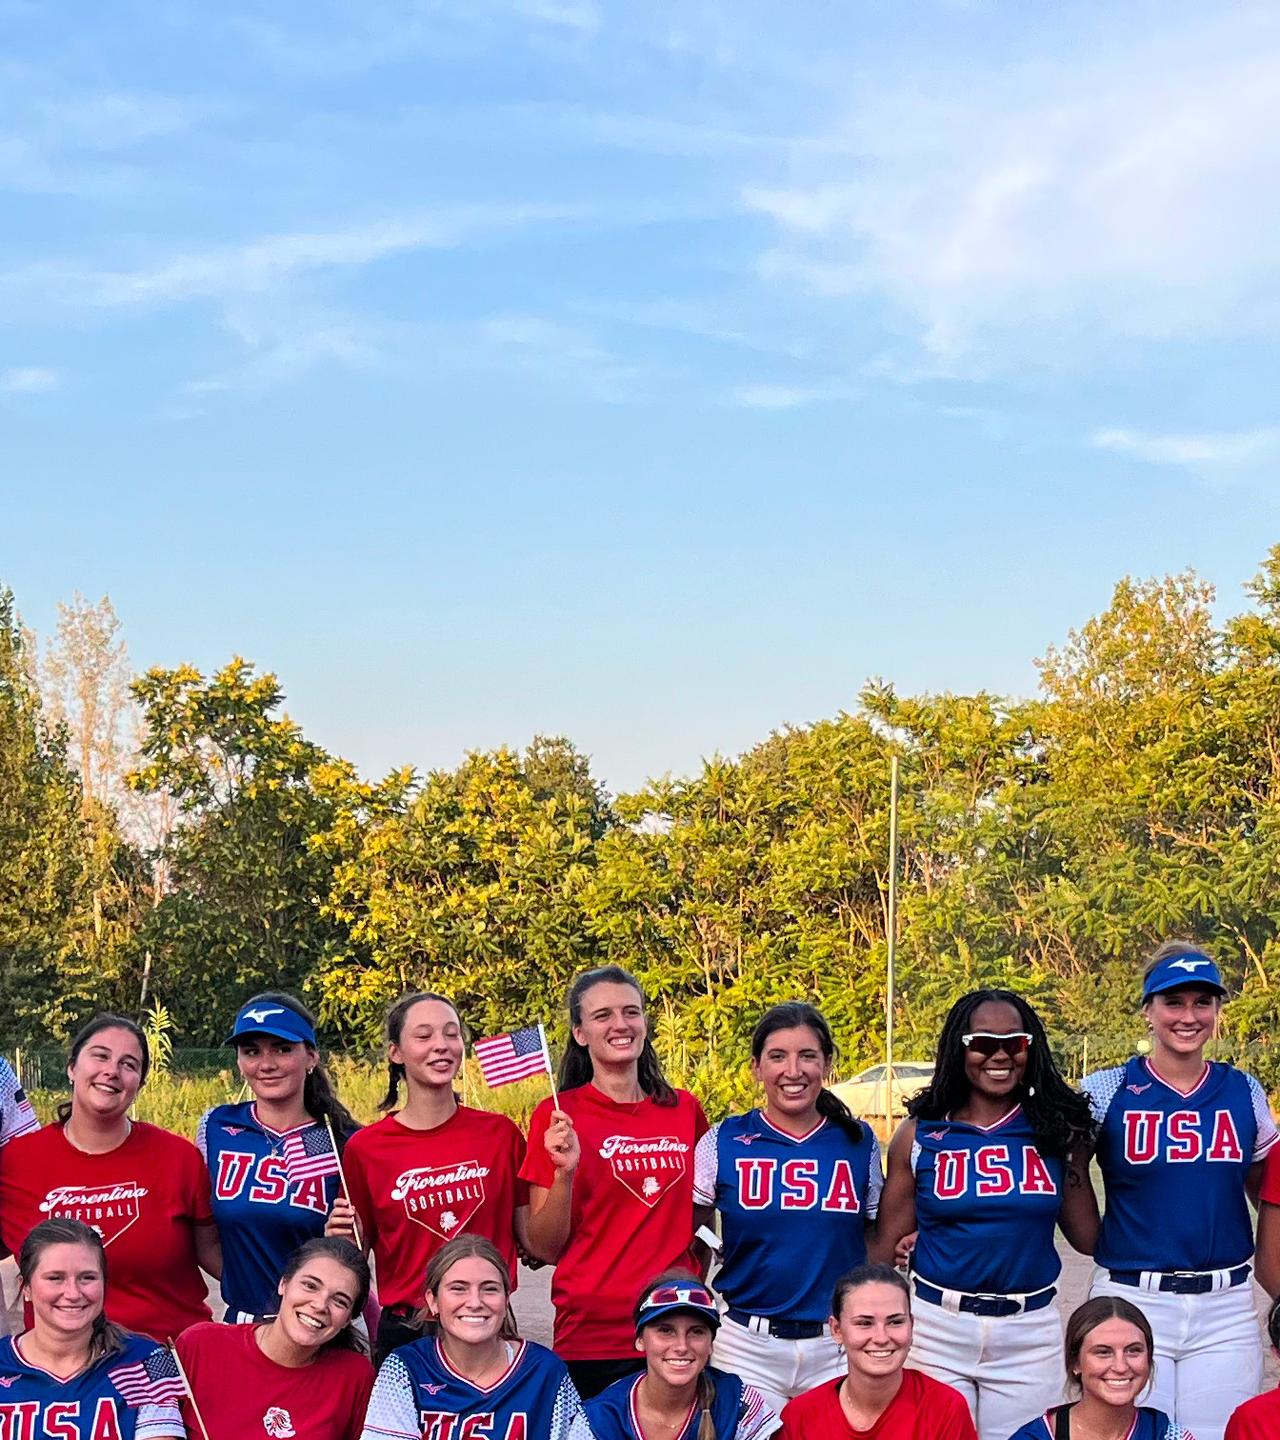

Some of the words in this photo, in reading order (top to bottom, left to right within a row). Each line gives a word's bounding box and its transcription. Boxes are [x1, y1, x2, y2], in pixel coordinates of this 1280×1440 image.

[599, 1135, 689, 1159] Fiorentina
[1123, 1110, 1243, 1165] USA
[616, 1156, 683, 1172] SOFTBALL
[934, 1145, 1057, 1200] USA
[39, 1186, 149, 1212] Fiorentina
[215, 1150, 329, 1215] USA
[391, 1165, 490, 1200] Fiorentina
[409, 1186, 481, 1212] SOFTBALL
[735, 1158, 861, 1213] USA
